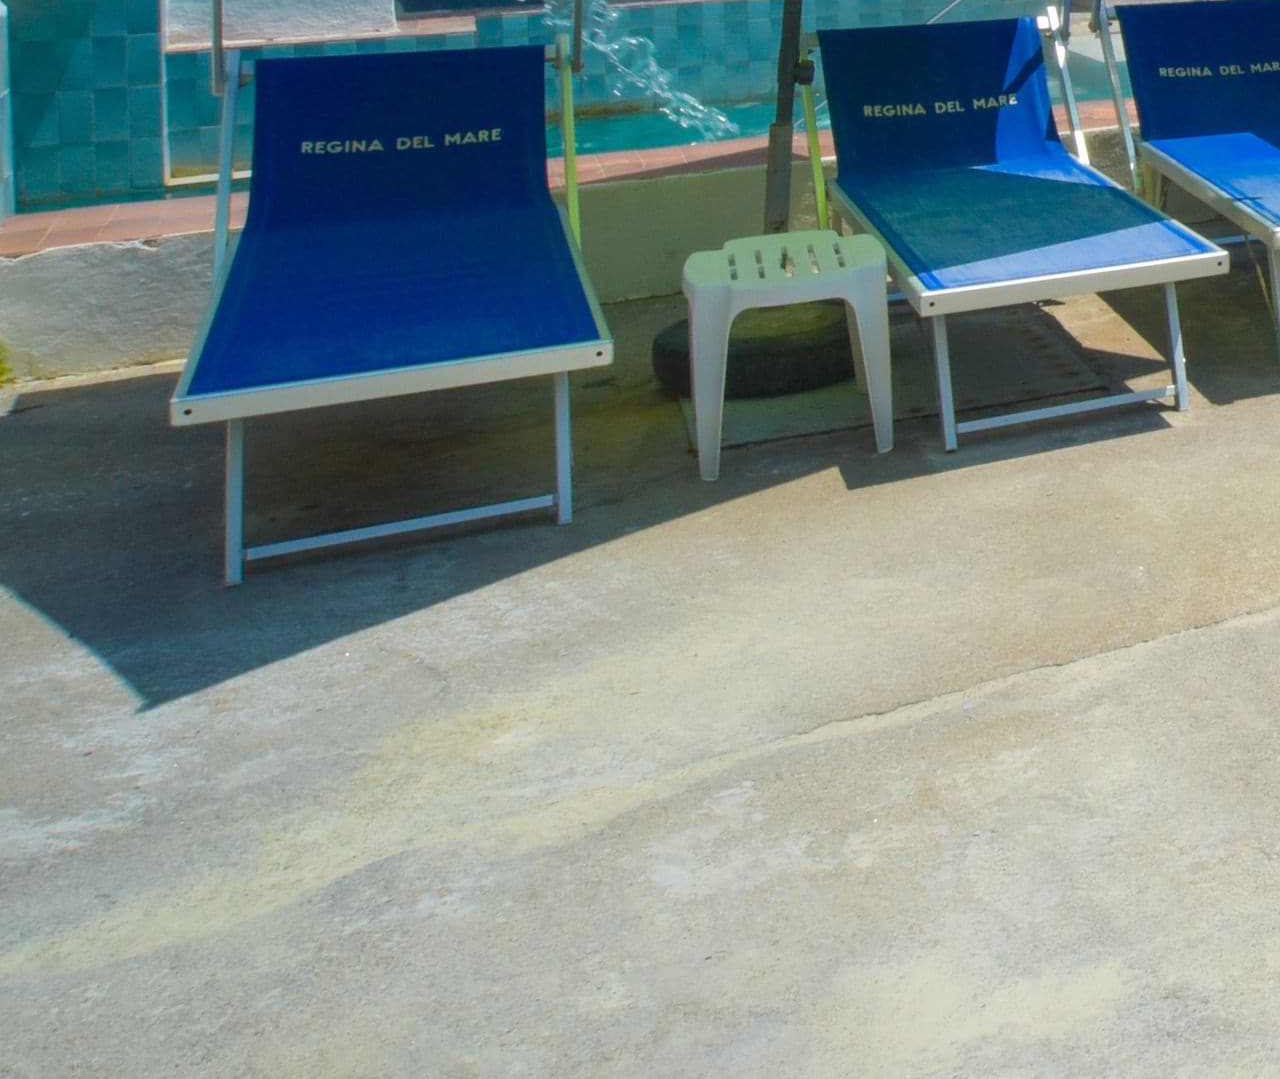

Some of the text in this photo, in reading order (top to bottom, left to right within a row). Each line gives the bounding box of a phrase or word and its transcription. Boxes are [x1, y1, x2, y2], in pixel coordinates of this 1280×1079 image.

[1159, 66, 1213, 78] REGINA
[1219, 64, 1245, 76] DEL
[863, 93, 1018, 117] REGINA DEL MARE
[301, 128, 502, 154] REGINA DEL MARE
